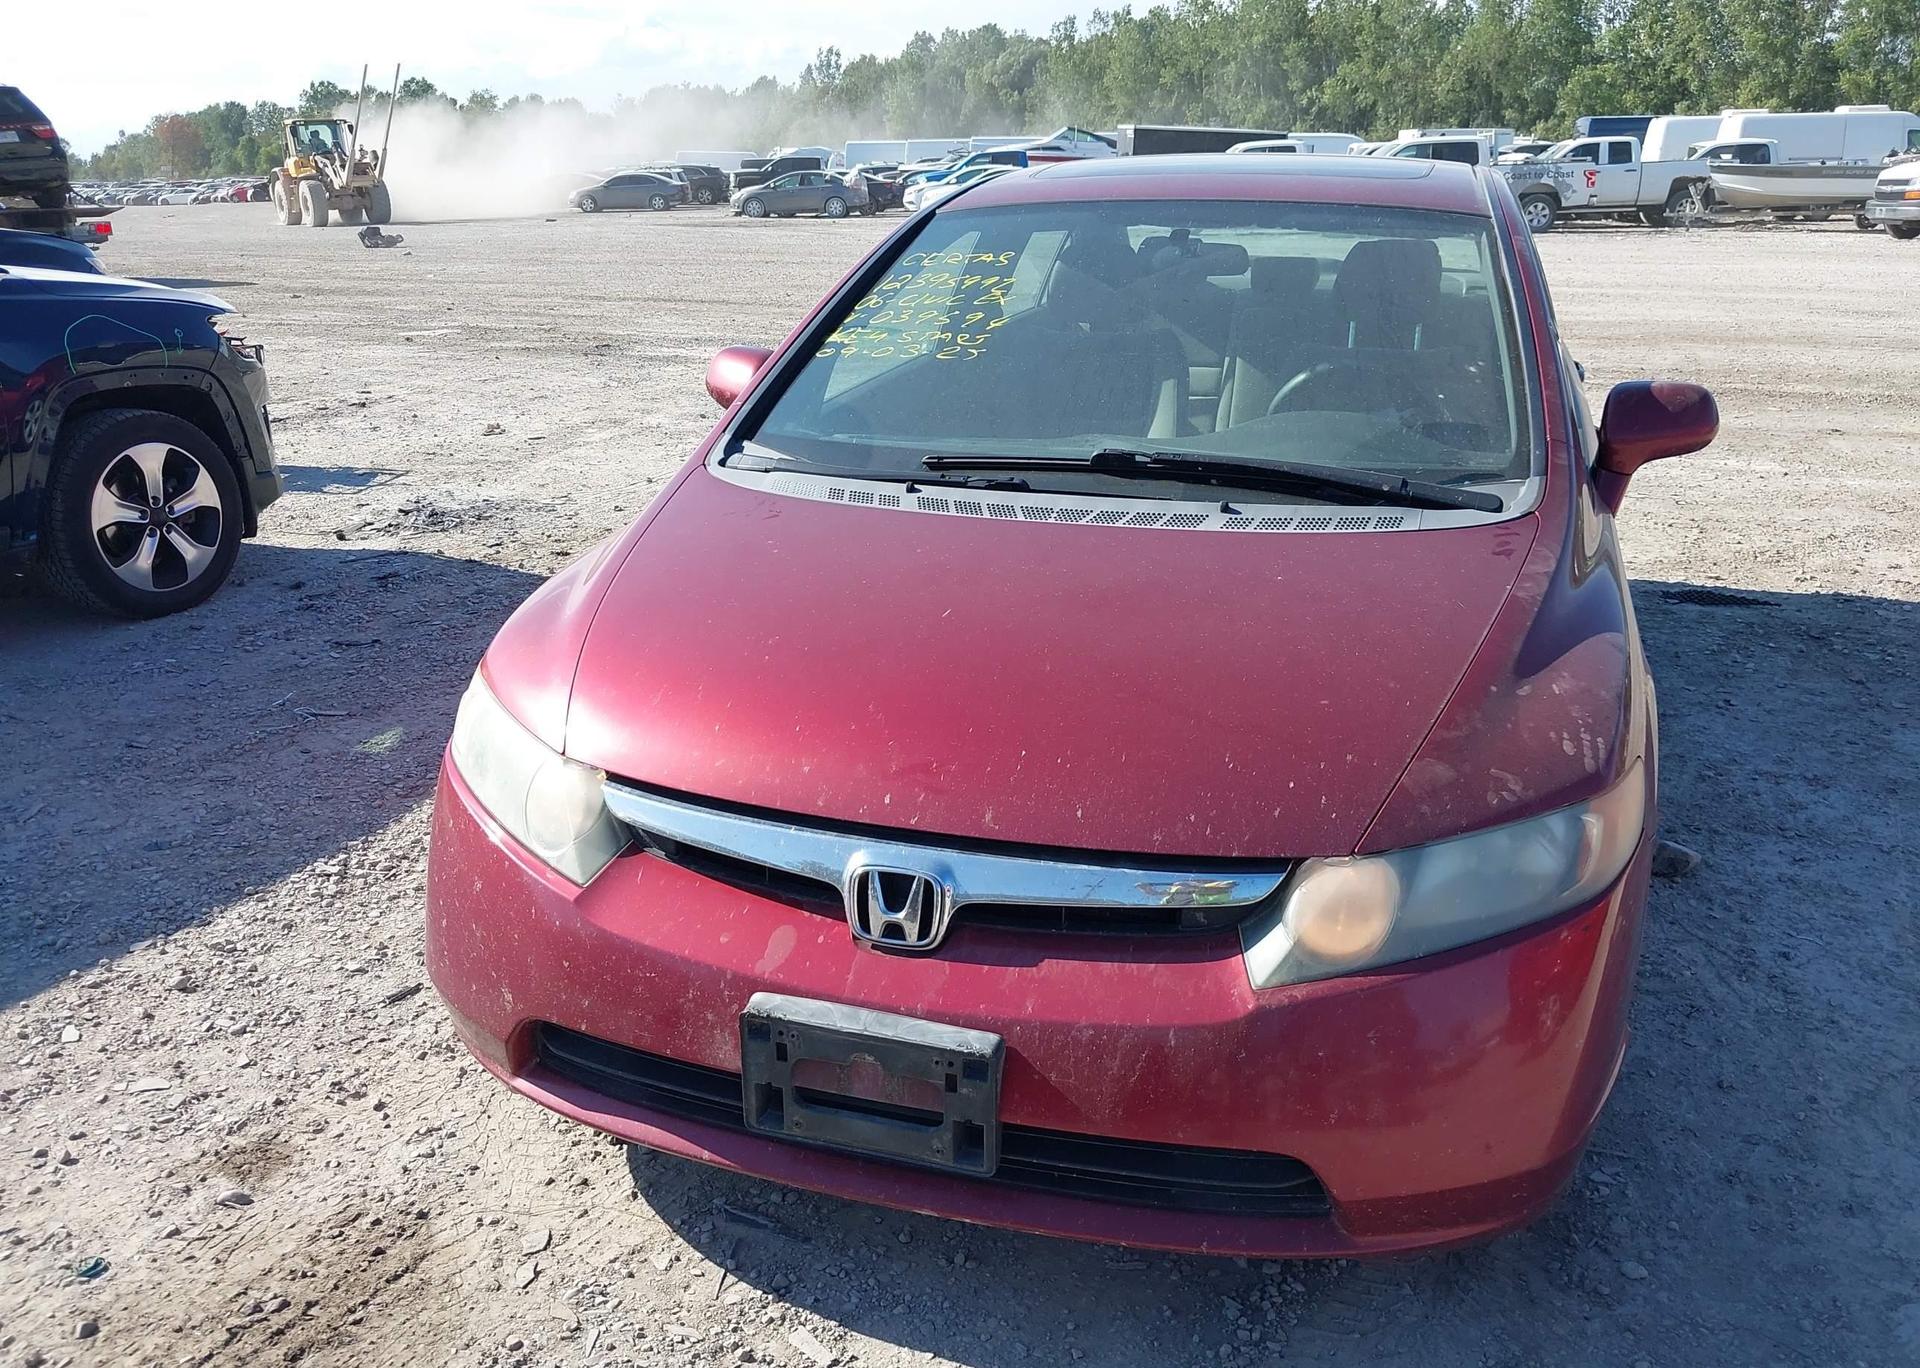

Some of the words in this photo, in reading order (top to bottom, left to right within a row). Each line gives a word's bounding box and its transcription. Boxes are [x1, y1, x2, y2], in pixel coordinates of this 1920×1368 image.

[1503, 171, 1532, 181] Coast
[1534, 171, 1544, 180] to
[1546, 170, 1575, 179] Coast
